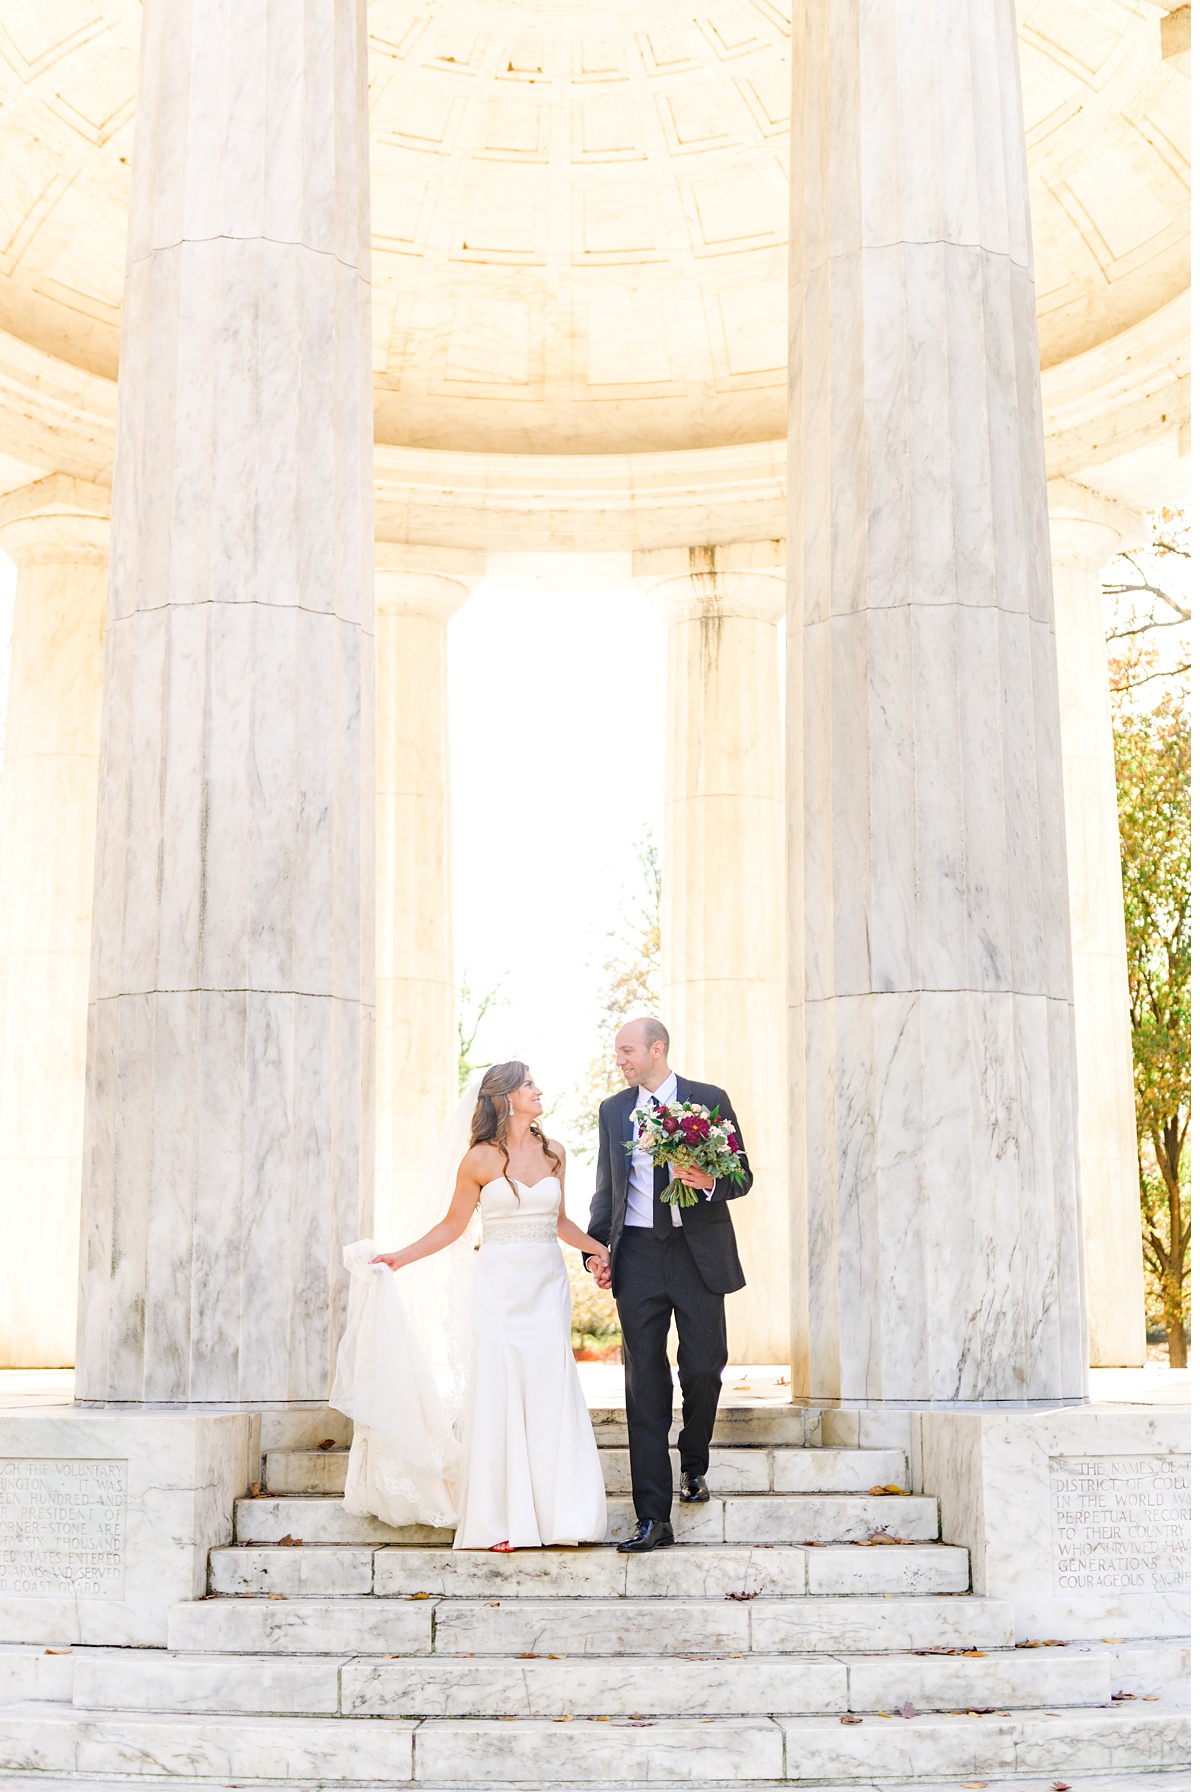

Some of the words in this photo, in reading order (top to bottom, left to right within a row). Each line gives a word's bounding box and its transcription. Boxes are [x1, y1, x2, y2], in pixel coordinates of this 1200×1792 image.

[27, 1463, 48, 1476] THE
[55, 1464, 122, 1477] VOLUNTARY
[1079, 1462, 1105, 1476] THE
[1111, 1461, 1154, 1474] NAMES
[1161, 1461, 1176, 1473] OF
[78, 1479, 91, 1491] IT
[97, 1480, 123, 1492] WAS
[1056, 1478, 1117, 1492] DISTRICT
[1127, 1478, 1143, 1490] OF
[30, 1493, 89, 1506] HUNDRED
[98, 1494, 122, 1507] AND
[1056, 1495, 1071, 1508] IN
[1079, 1494, 1106, 1508] THE
[1115, 1493, 1164, 1507] WORLD
[21, 1507, 94, 1521] PRESIDENT
[104, 1508, 121, 1521] OF
[1057, 1510, 1136, 1524] PERPETUAL
[1144, 1508, 1191, 1522] RECOR
[96, 1524, 120, 1536] ARE
[1058, 1527, 1076, 1540] TO
[1084, 1526, 1121, 1540] THEIR
[1128, 1524, 1184, 1539] COUNTRY
[55, 1536, 121, 1551] THOUSAND
[1058, 1543, 1092, 1556] WHO
[1100, 1540, 1158, 1555] SURVIVED
[22, 1551, 61, 1564] STATES
[68, 1552, 121, 1566] ENTERED
[1058, 1556, 1158, 1572] GENERATIONS
[14, 1565, 44, 1578] ARMS
[79, 1567, 120, 1580] SERVED
[14, 1580, 52, 1592] COAST
[1058, 1573, 1145, 1588] COURAGEOUS
